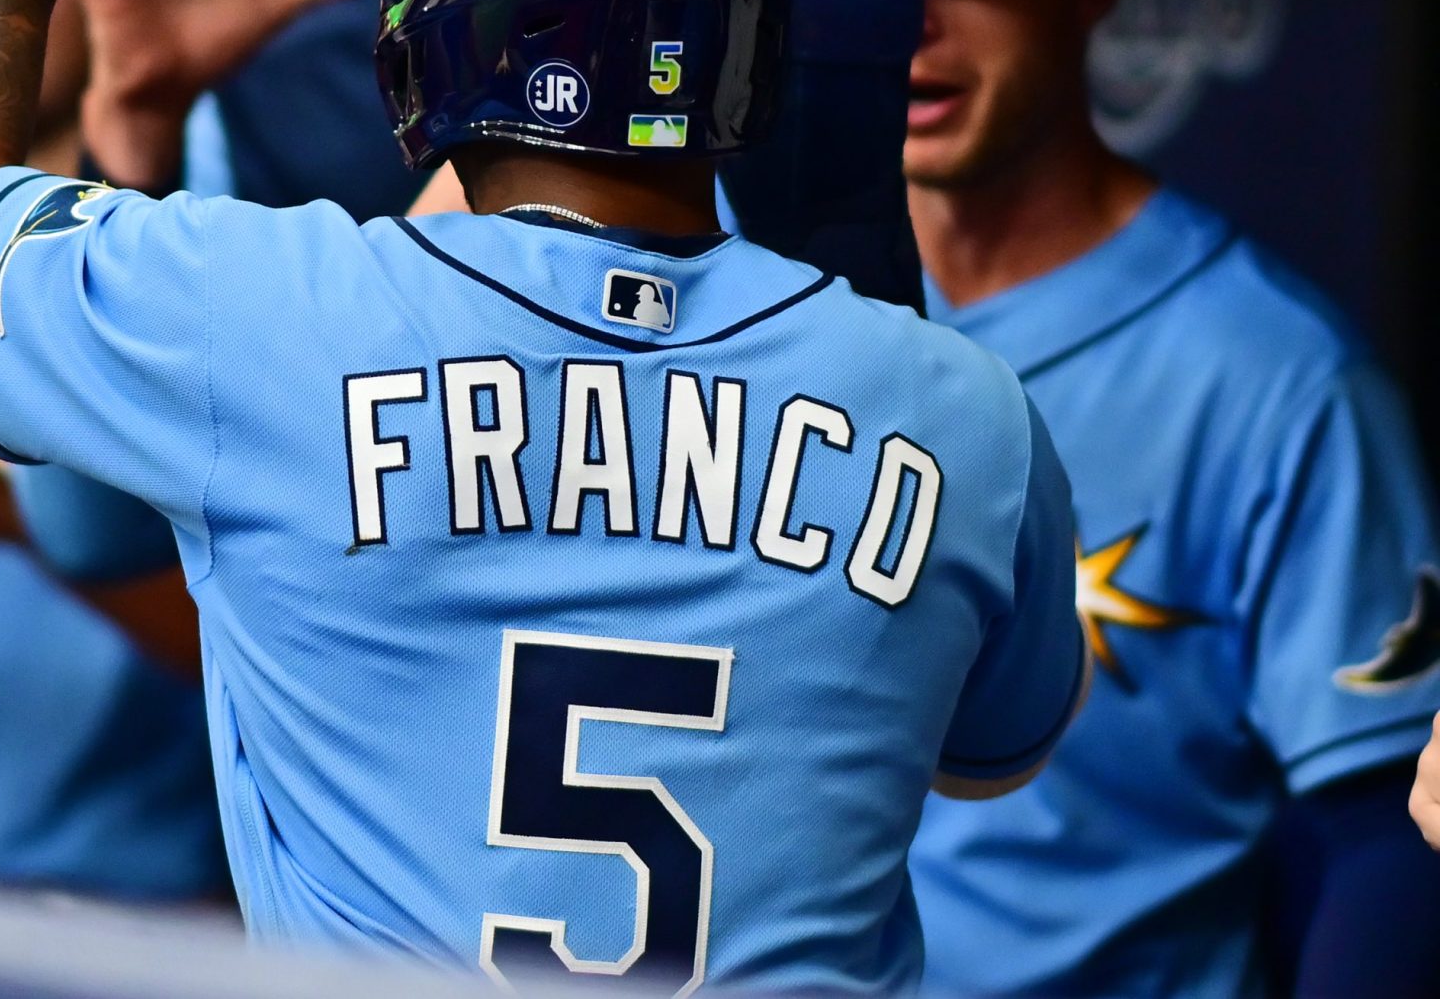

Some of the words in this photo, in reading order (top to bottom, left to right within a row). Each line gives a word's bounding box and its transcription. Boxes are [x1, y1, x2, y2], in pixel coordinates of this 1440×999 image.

[534, 74, 579, 114] JR
[649, 41, 684, 95] 5
[342, 354, 944, 613] FRANCO
[478, 628, 734, 999] 5
